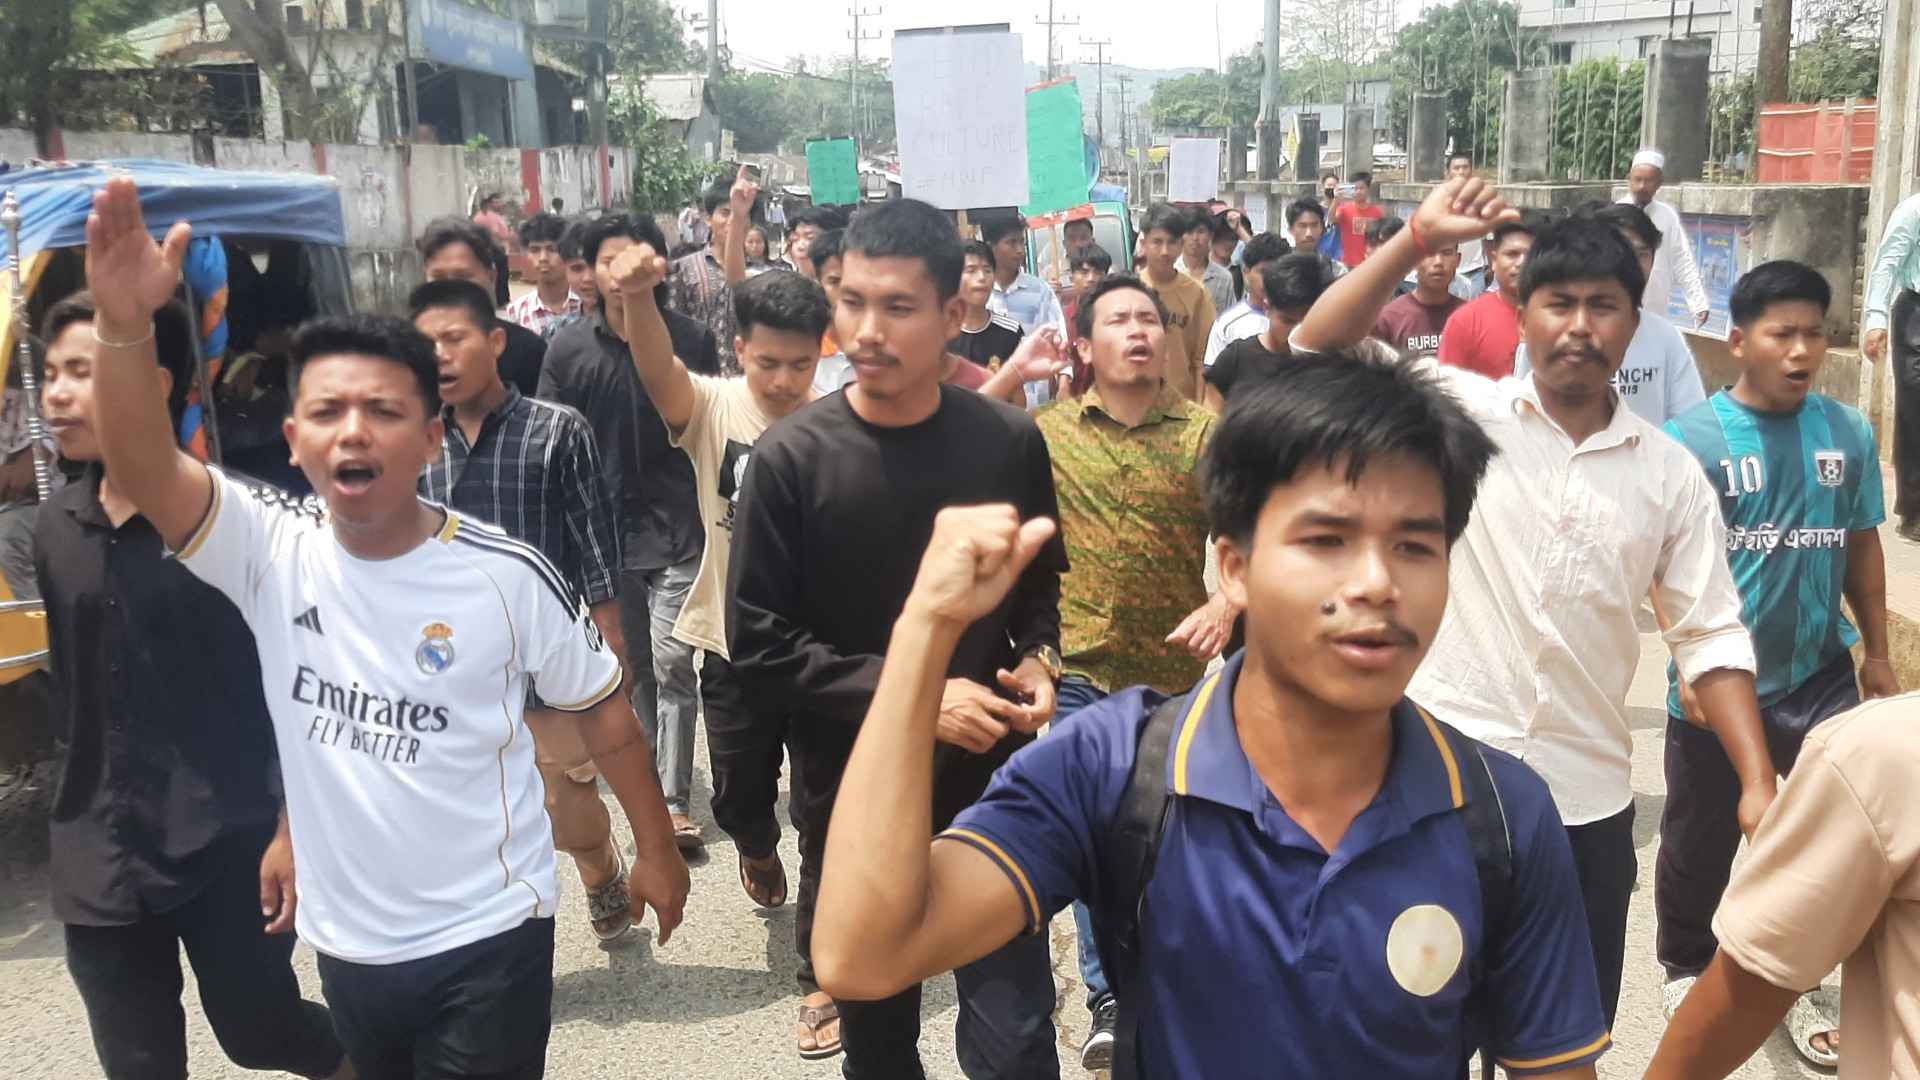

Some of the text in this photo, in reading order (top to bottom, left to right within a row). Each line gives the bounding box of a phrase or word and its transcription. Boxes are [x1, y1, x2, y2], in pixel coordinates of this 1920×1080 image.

[1407, 335, 1444, 350] BURB
[1719, 456, 1762, 497] 10
[1784, 527, 1847, 549] একাদশ
[291, 664, 449, 732] Emirates
[307, 715, 421, 764] FLY BETTER
